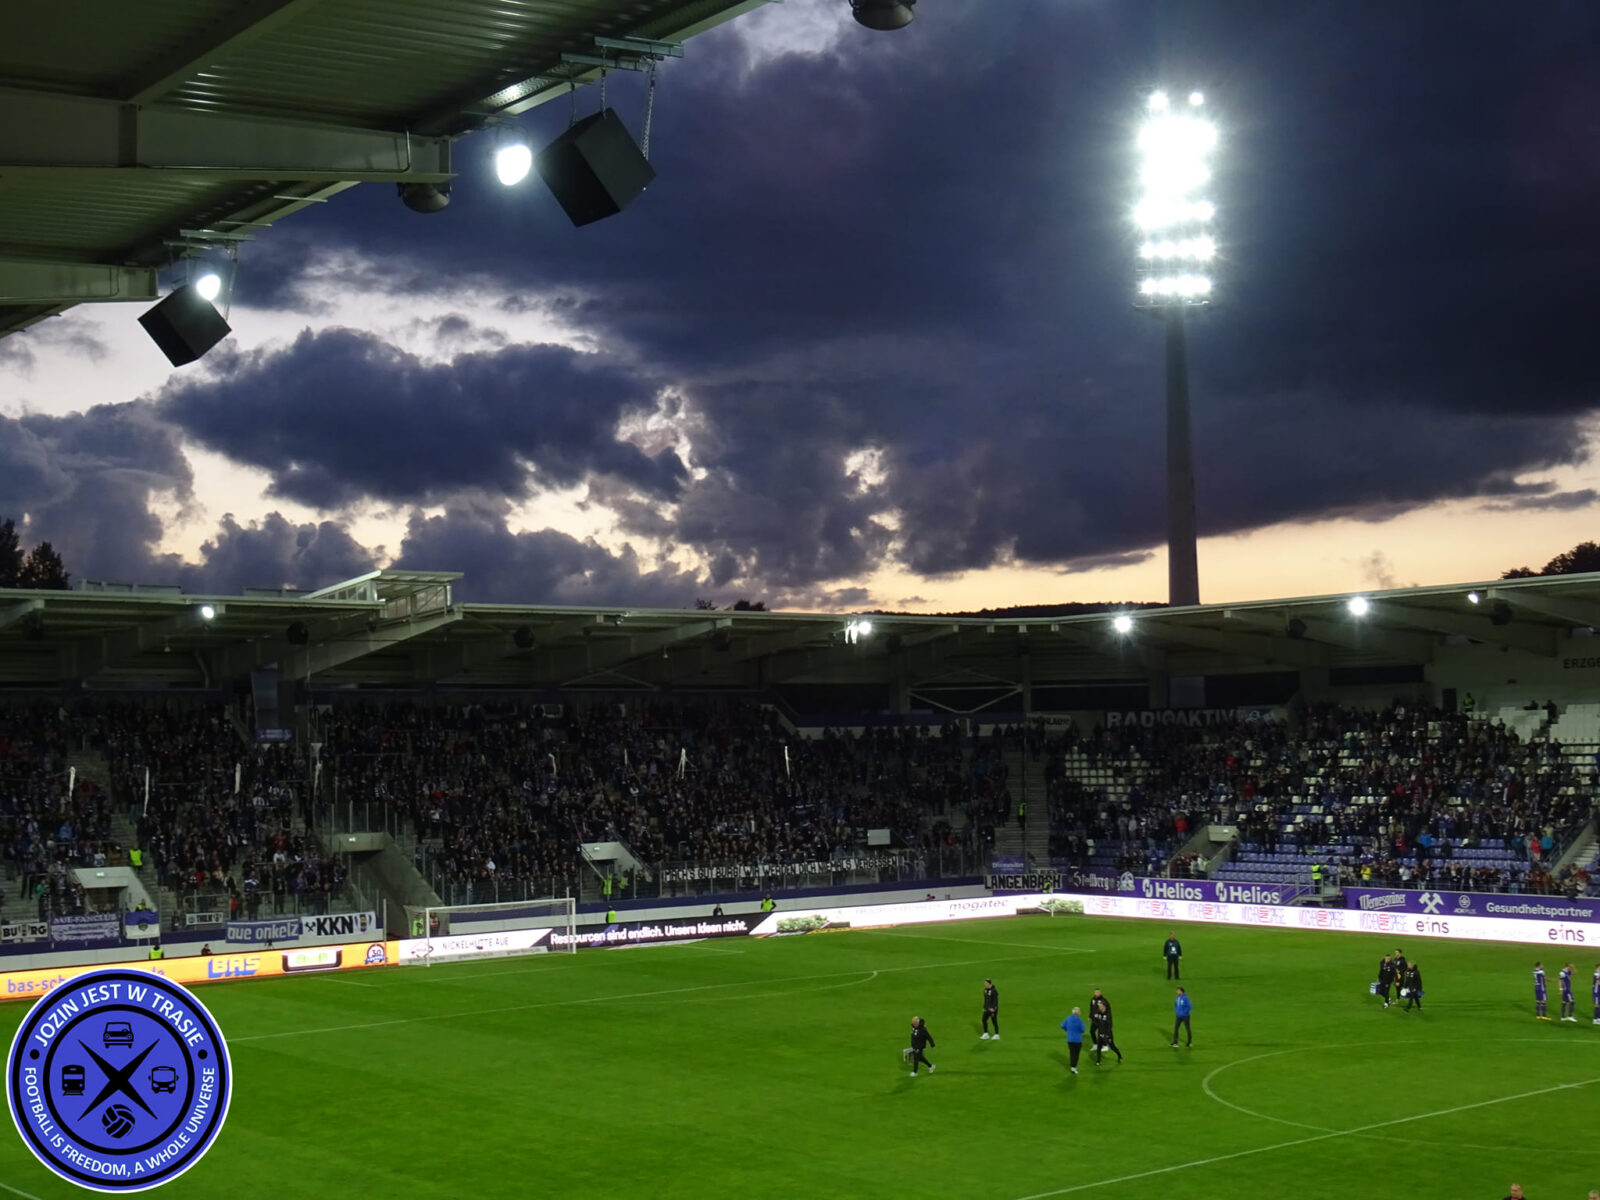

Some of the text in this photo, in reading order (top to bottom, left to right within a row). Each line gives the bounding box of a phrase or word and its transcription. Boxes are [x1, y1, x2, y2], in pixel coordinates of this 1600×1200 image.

[1155, 881, 1203, 901] Helios
[1230, 885, 1281, 905] Helios
[948, 899, 1009, 912] mogatec
[1486, 902, 1593, 921] Gesundheitspartner
[316, 915, 354, 936] KKN
[607, 927, 627, 941] sind
[1416, 916, 1450, 935] eins
[1548, 923, 1586, 943] eins
